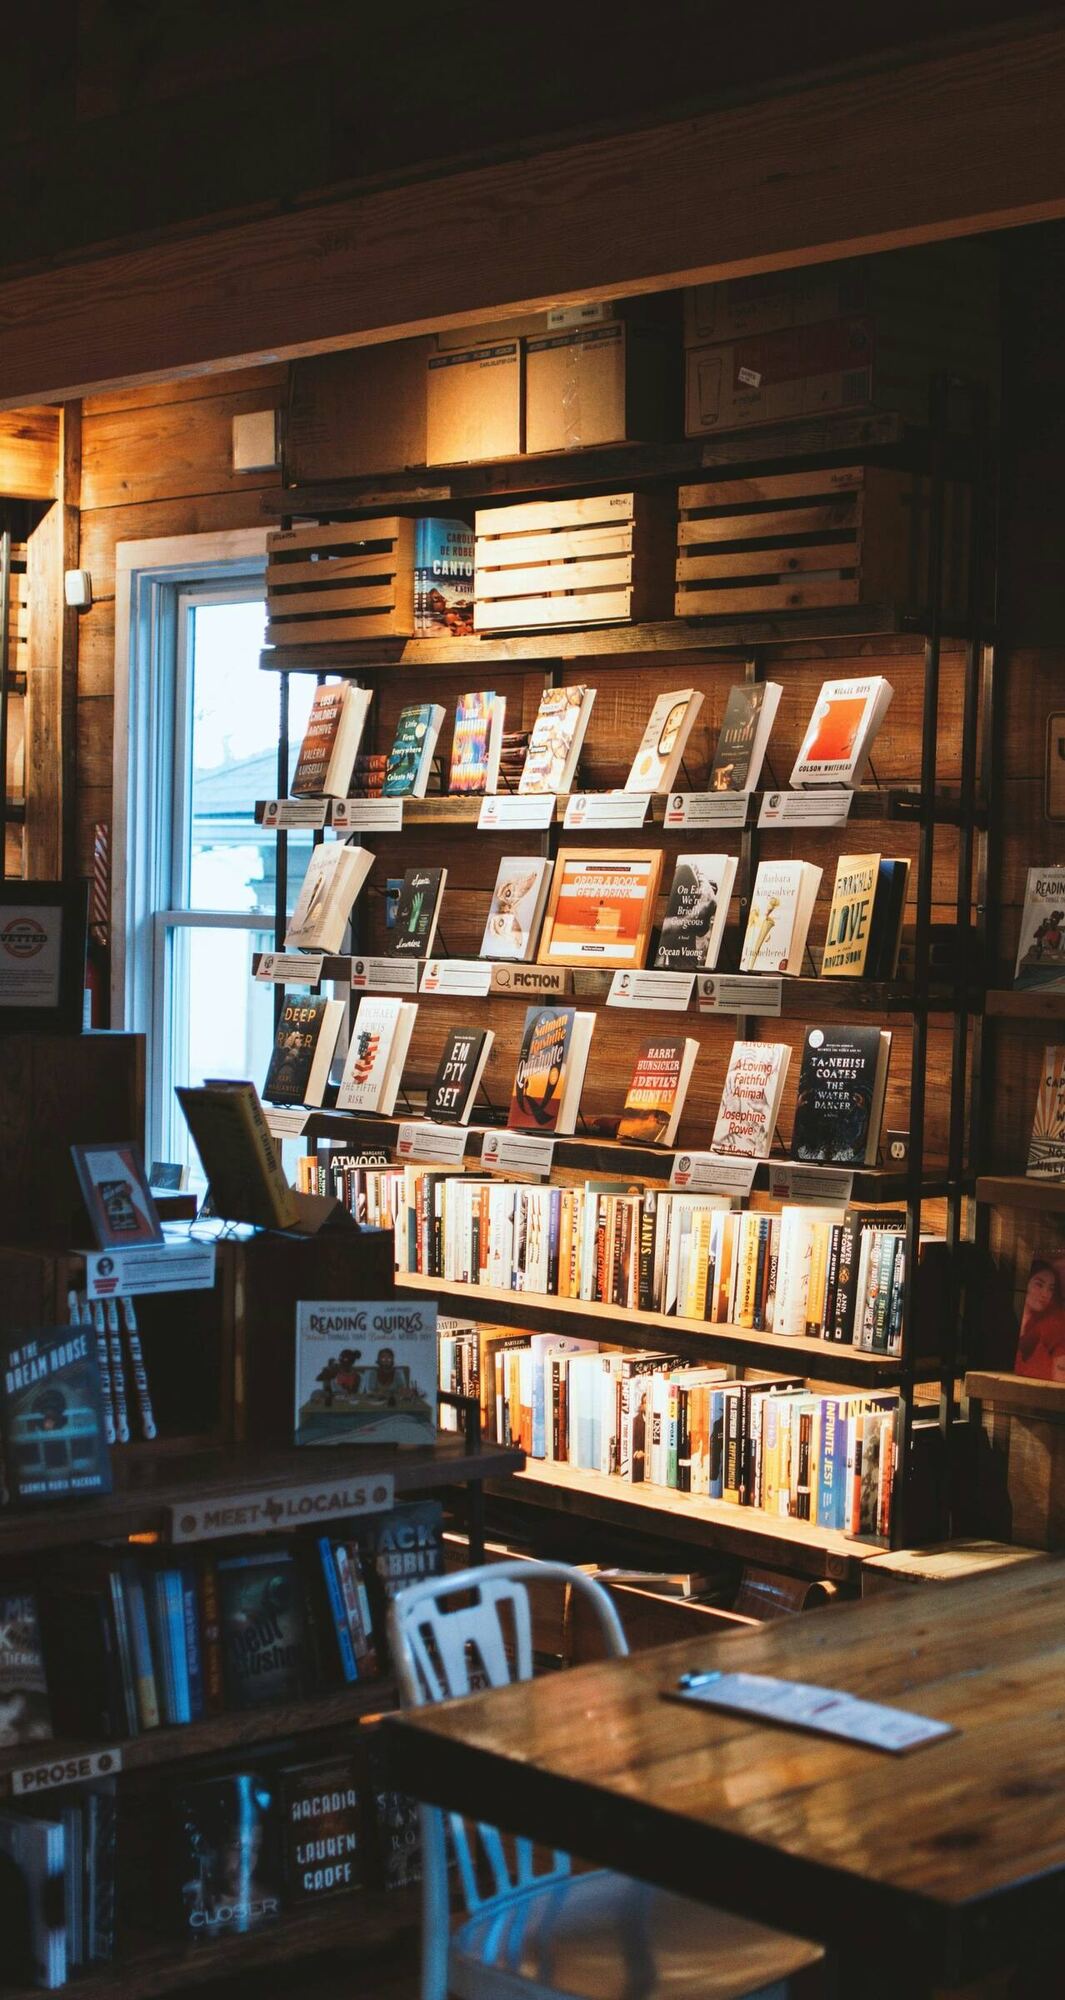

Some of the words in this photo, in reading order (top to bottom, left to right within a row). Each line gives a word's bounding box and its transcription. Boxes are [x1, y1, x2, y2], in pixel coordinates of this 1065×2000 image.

[614, 877, 640, 886] BOOK
[678, 885, 689, 894] On
[671, 918, 704, 929] Gorgeous
[828, 900, 870, 946] LOVE
[0, 934, 47, 943] VETTED
[658, 946, 680, 956] Ocean
[681, 947, 704, 960] Vuong
[514, 973, 560, 988] FICTION
[284, 1007, 316, 1022] DEEP
[535, 1014, 569, 1038] Salman
[451, 1042, 470, 1062] EM
[648, 1049, 676, 1059] HARRY
[442, 1063, 467, 1082] PTY
[637, 1060, 680, 1071] HUNSICKER
[736, 1062, 742, 1071] A
[734, 1073, 768, 1085] Faithful
[816, 1069, 857, 1079] COATES
[733, 1087, 764, 1099] Animal
[826, 1081, 844, 1090] THE
[347, 1094, 364, 1104] RISK
[436, 1087, 459, 1107] SET
[630, 1089, 674, 1104] COUNTRY
[818, 1090, 850, 1100] WATER
[814, 1101, 850, 1110] DANCER
[722, 1108, 766, 1123] Josephine
[729, 1123, 754, 1135] Rowe
[330, 1156, 388, 1169] ATWOOD
[641, 1215, 653, 1254] JANIS
[845, 1235, 853, 1265] RAVEN
[747, 1265, 752, 1276] OF
[769, 1256, 778, 1293] KOONTZ
[310, 1312, 367, 1334] READING
[373, 1312, 423, 1333] QUIRKS
[9, 1351, 20, 1367] IN
[22, 1341, 38, 1362] THE
[5, 1355, 48, 1393] DREAM
[50, 1334, 88, 1372] HOUSE
[825, 1401, 836, 1457] INFINITE
[824, 1459, 833, 1489] JEST
[203, 1505, 260, 1530] MEET
[286, 1488, 367, 1516] LOCALS
[22, 1758, 90, 1789] PROSE
[292, 1790, 357, 1822] ARCADIA
[296, 1832, 356, 1864] LAUREN
[304, 1862, 353, 1891] GROFF
[189, 1898, 278, 1927] CLOSER
